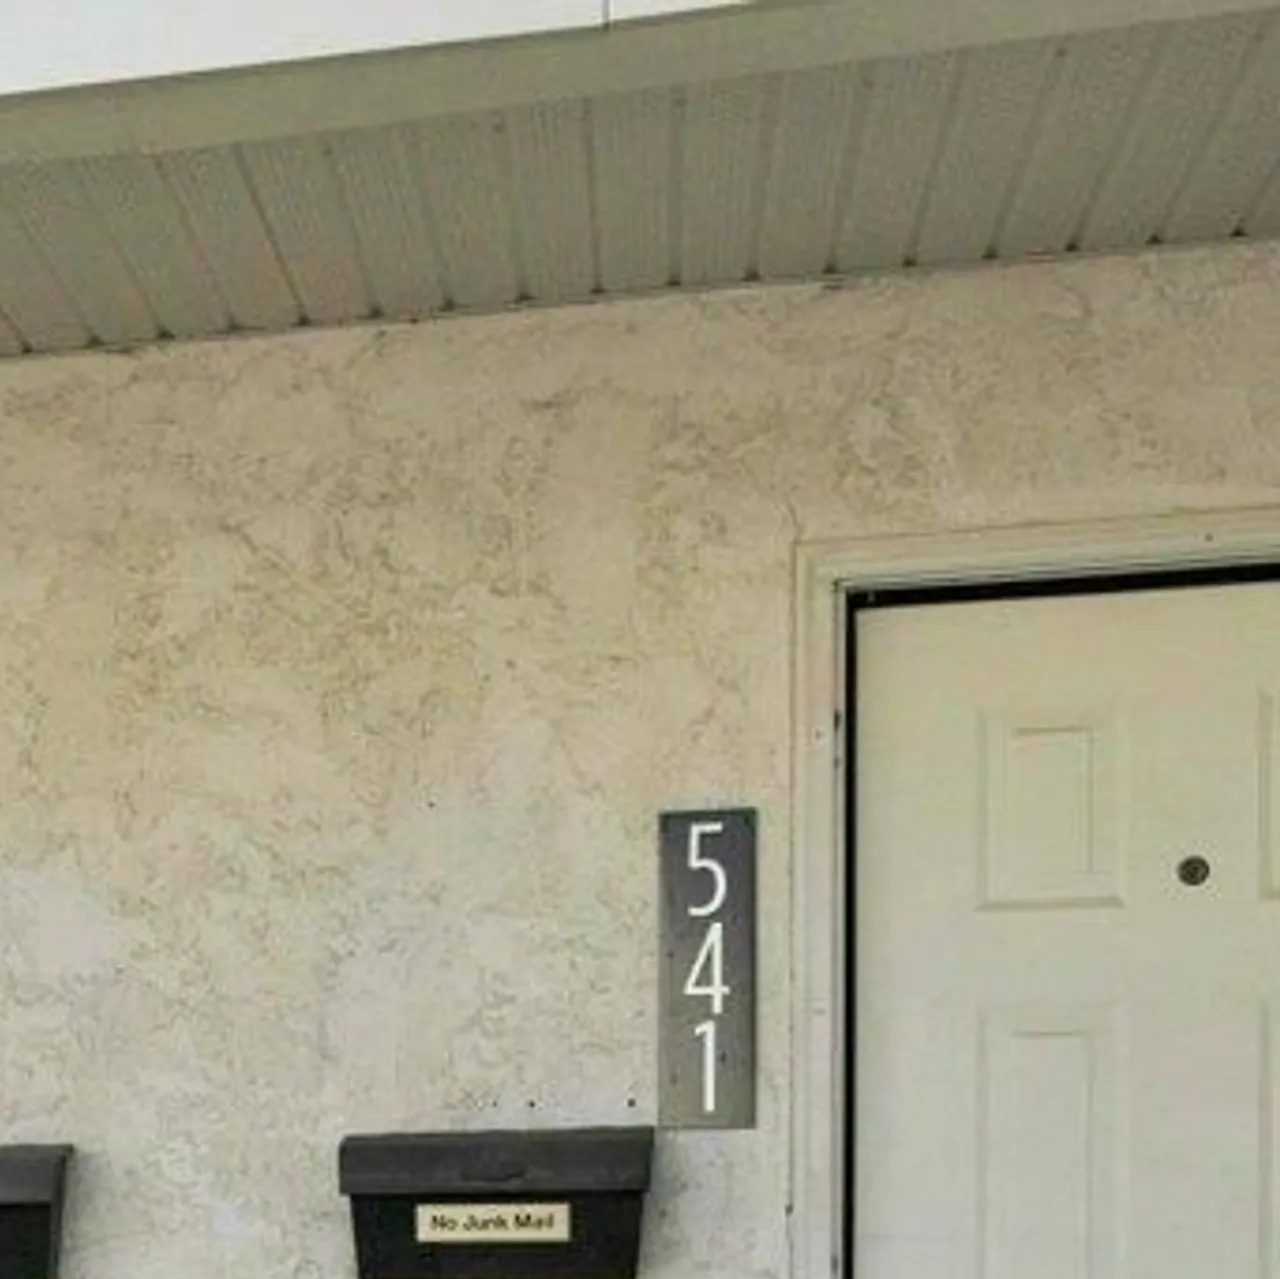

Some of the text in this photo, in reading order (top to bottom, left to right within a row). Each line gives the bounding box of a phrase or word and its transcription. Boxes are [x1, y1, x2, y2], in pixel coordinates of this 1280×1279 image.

[683, 821, 731, 1112] 541
[430, 1212, 555, 1231] No Junk Mail
